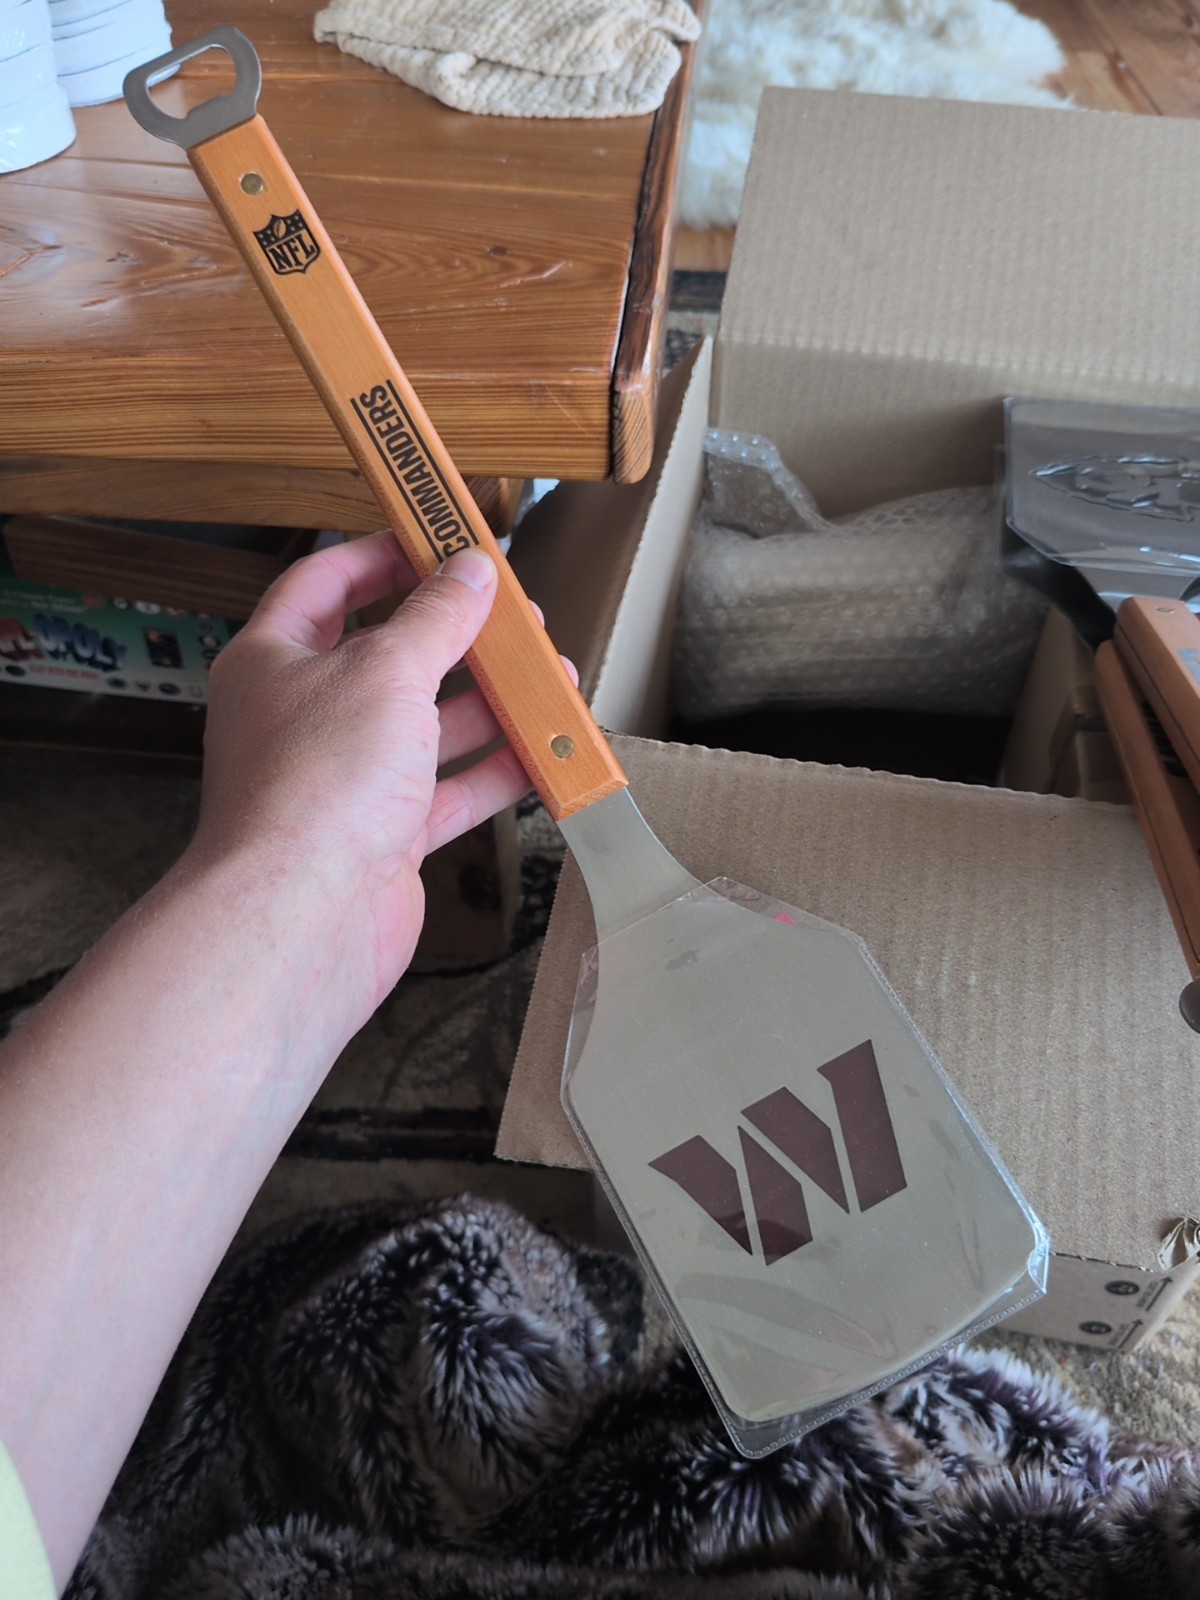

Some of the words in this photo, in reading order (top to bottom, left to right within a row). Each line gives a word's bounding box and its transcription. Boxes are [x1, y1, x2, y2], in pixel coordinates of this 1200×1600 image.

[268, 234, 315, 270] NFL
[359, 384, 471, 558] COMMANDERS
[648, 1039, 907, 1266] W
